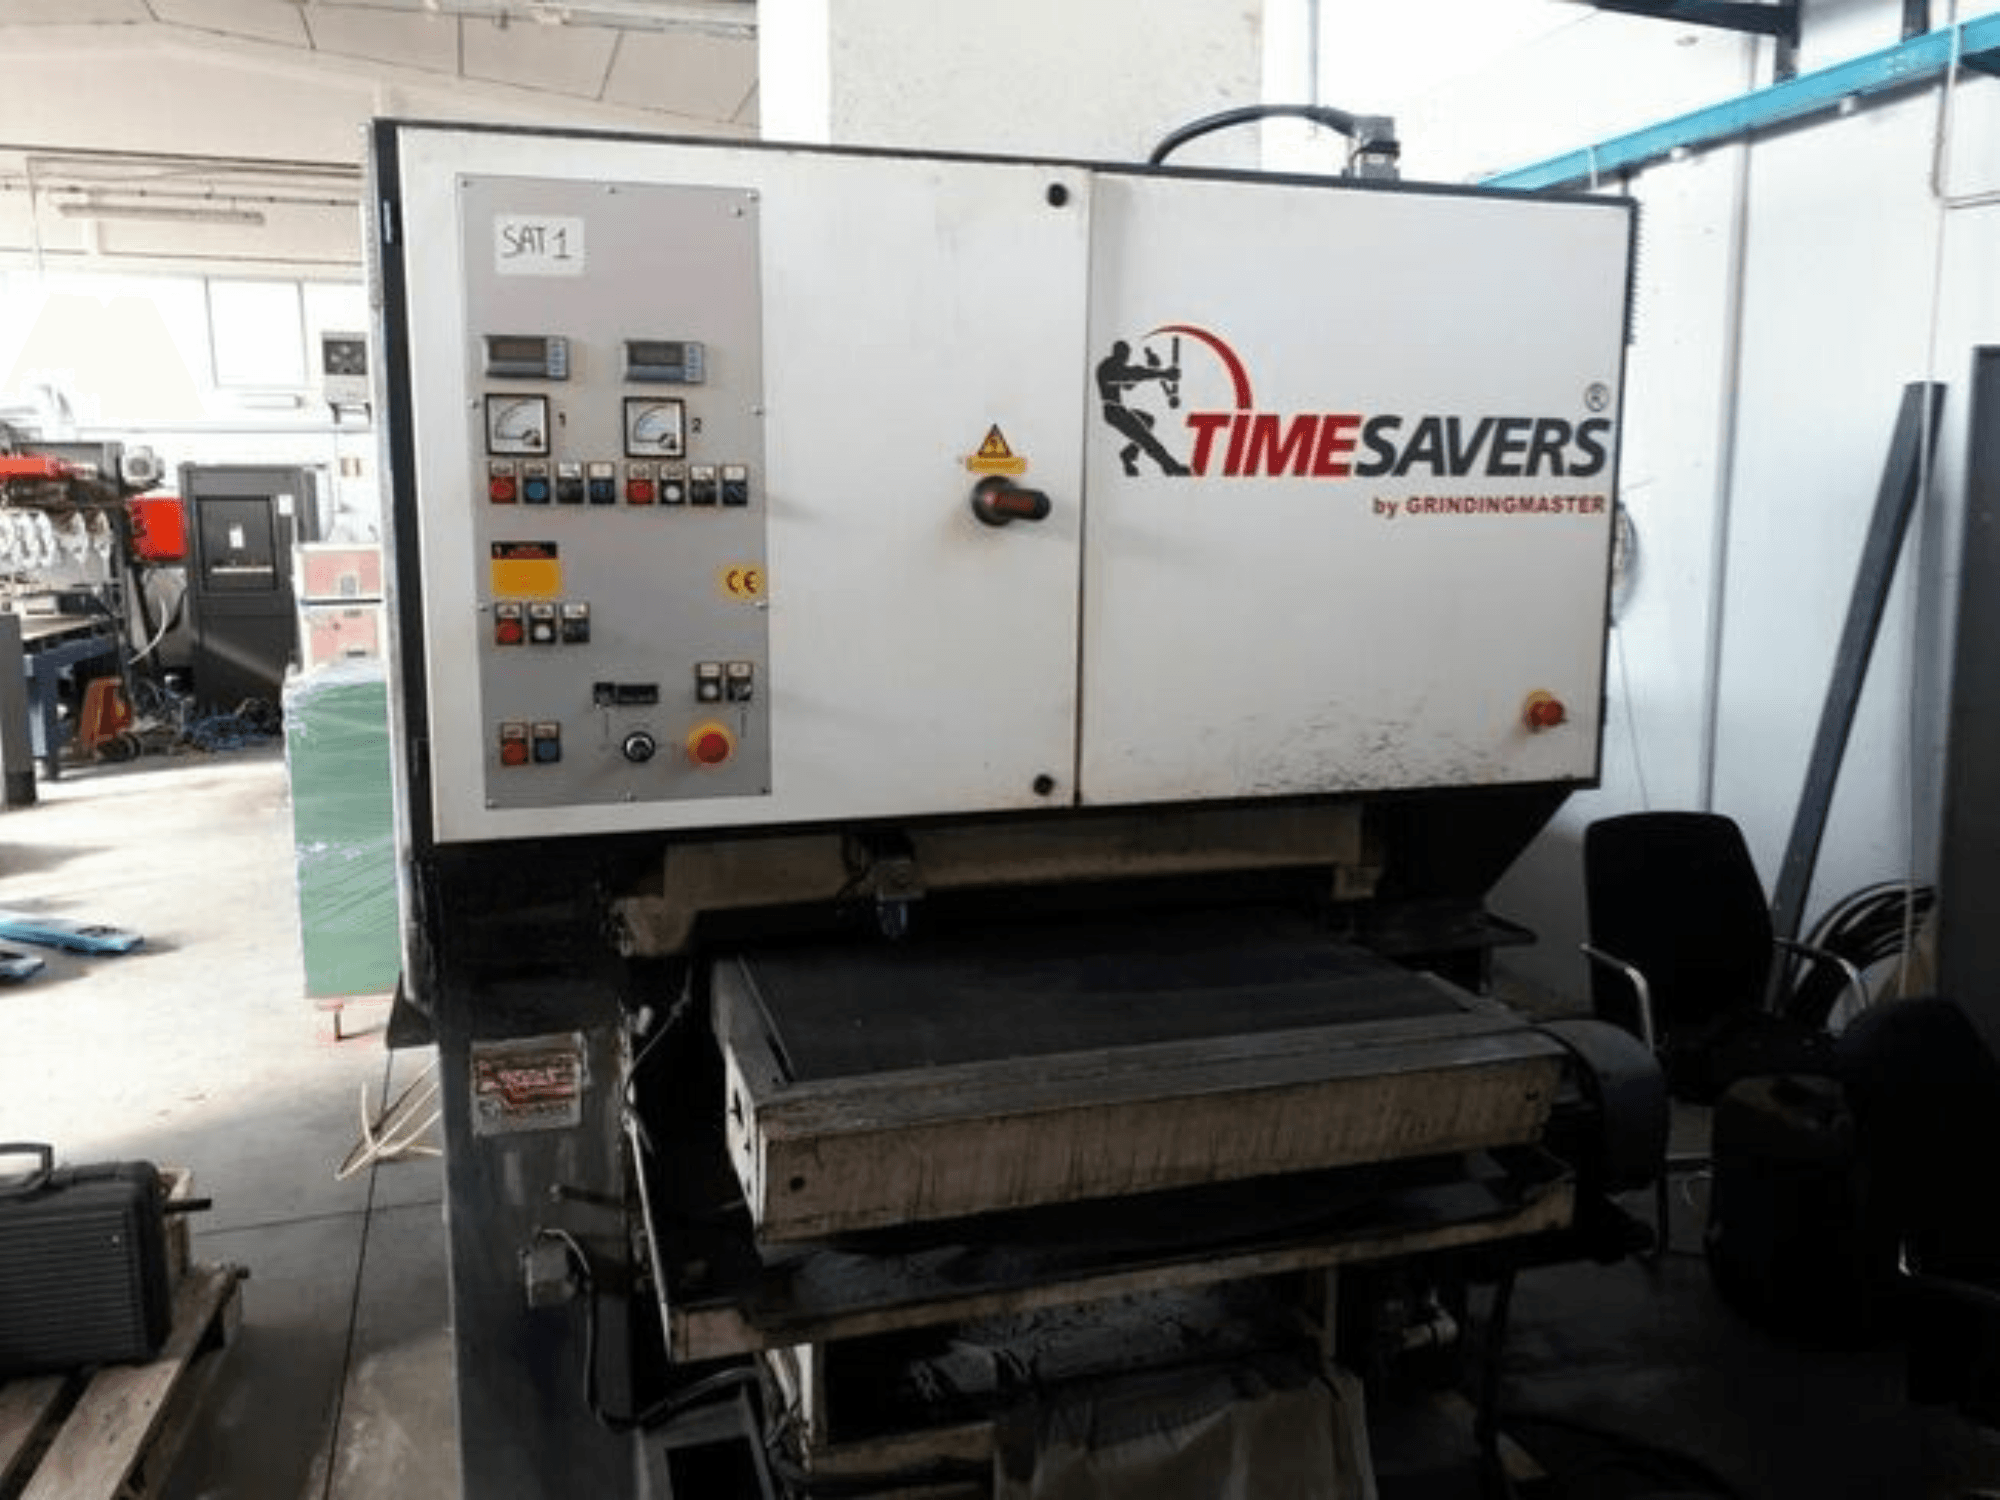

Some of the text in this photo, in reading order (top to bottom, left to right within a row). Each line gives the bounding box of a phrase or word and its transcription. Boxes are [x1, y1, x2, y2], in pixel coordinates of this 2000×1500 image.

[501, 224, 573, 259] SAT 1
[691, 416, 702, 433] 2
[1186, 413, 1612, 477] TIMESAVERS
[1372, 496, 1606, 519] by GRINDINGMASTER
[726, 569, 758, 594] CE
